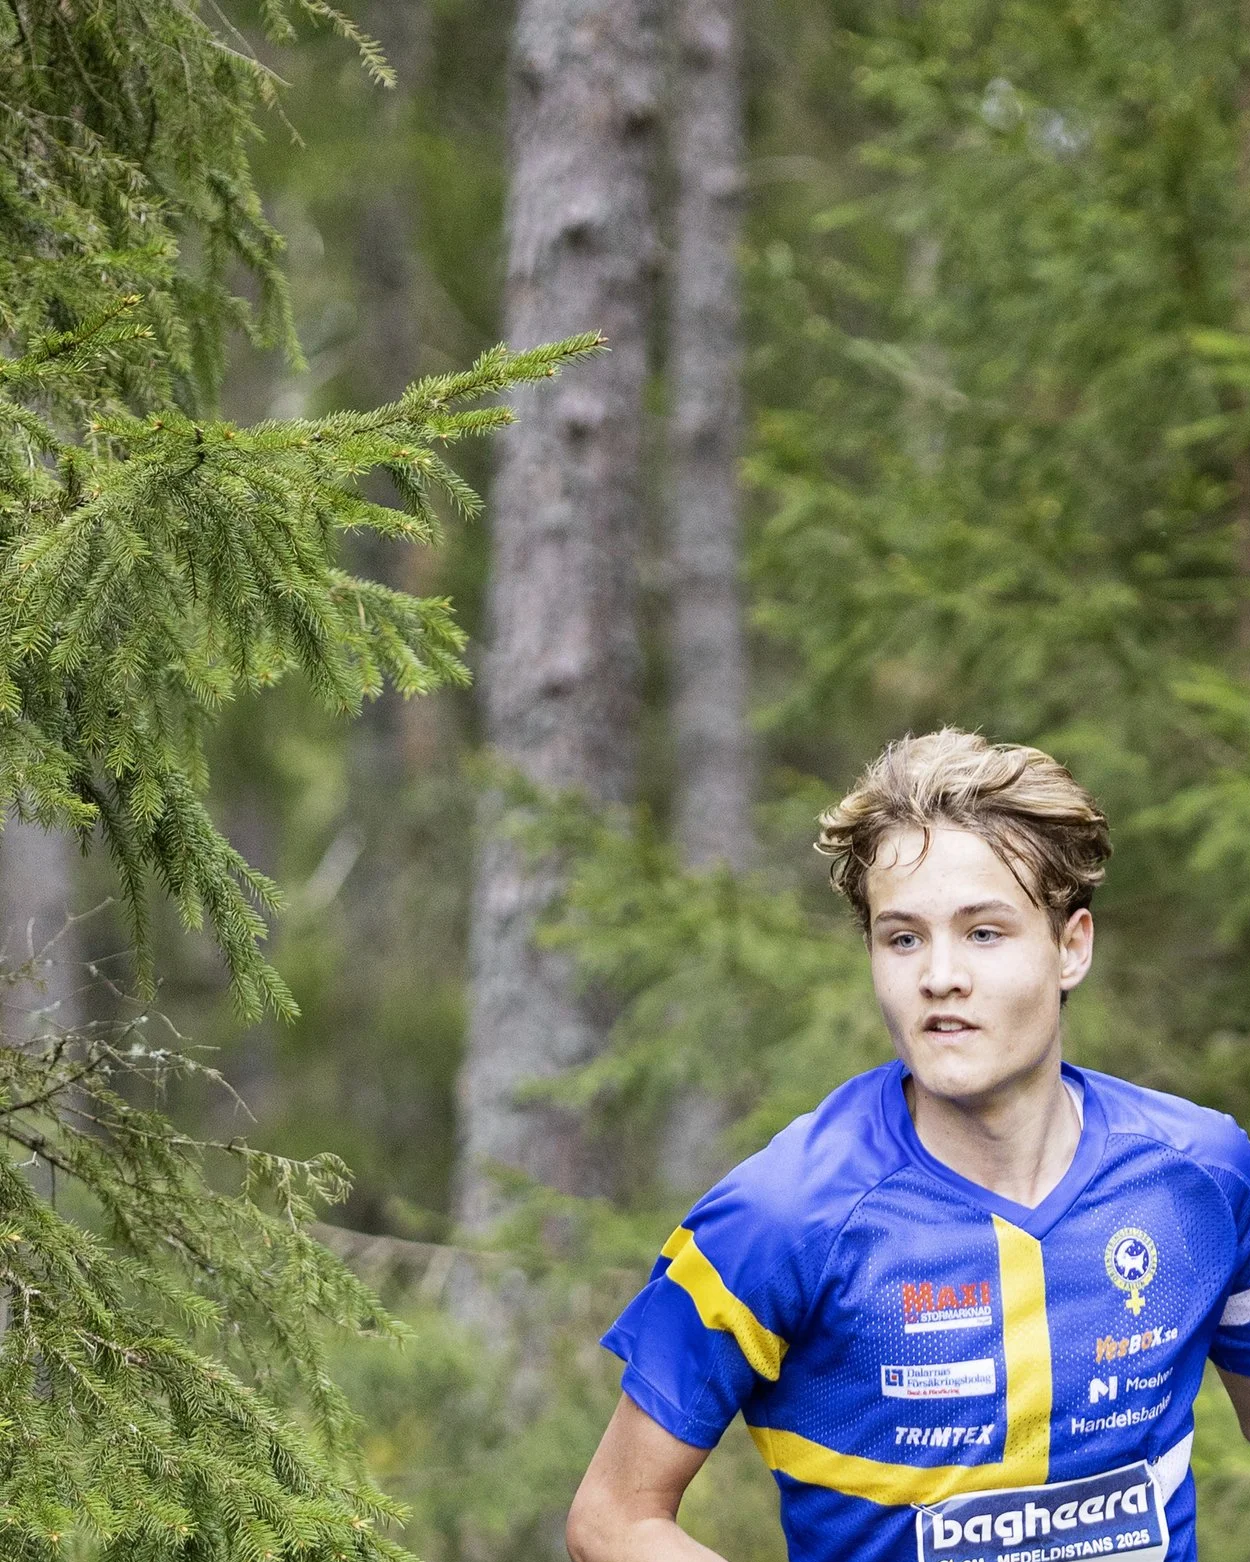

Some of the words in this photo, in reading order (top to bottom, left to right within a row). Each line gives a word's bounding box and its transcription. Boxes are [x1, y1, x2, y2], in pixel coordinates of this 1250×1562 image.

[920, 1306, 991, 1322] STORMARKNAD
[907, 1367, 951, 1378] Dalarnas
[895, 1424, 995, 1447] TRIMTEX
[932, 1482, 1150, 1549] bagheera
[1116, 1529, 1150, 1549] 2025
